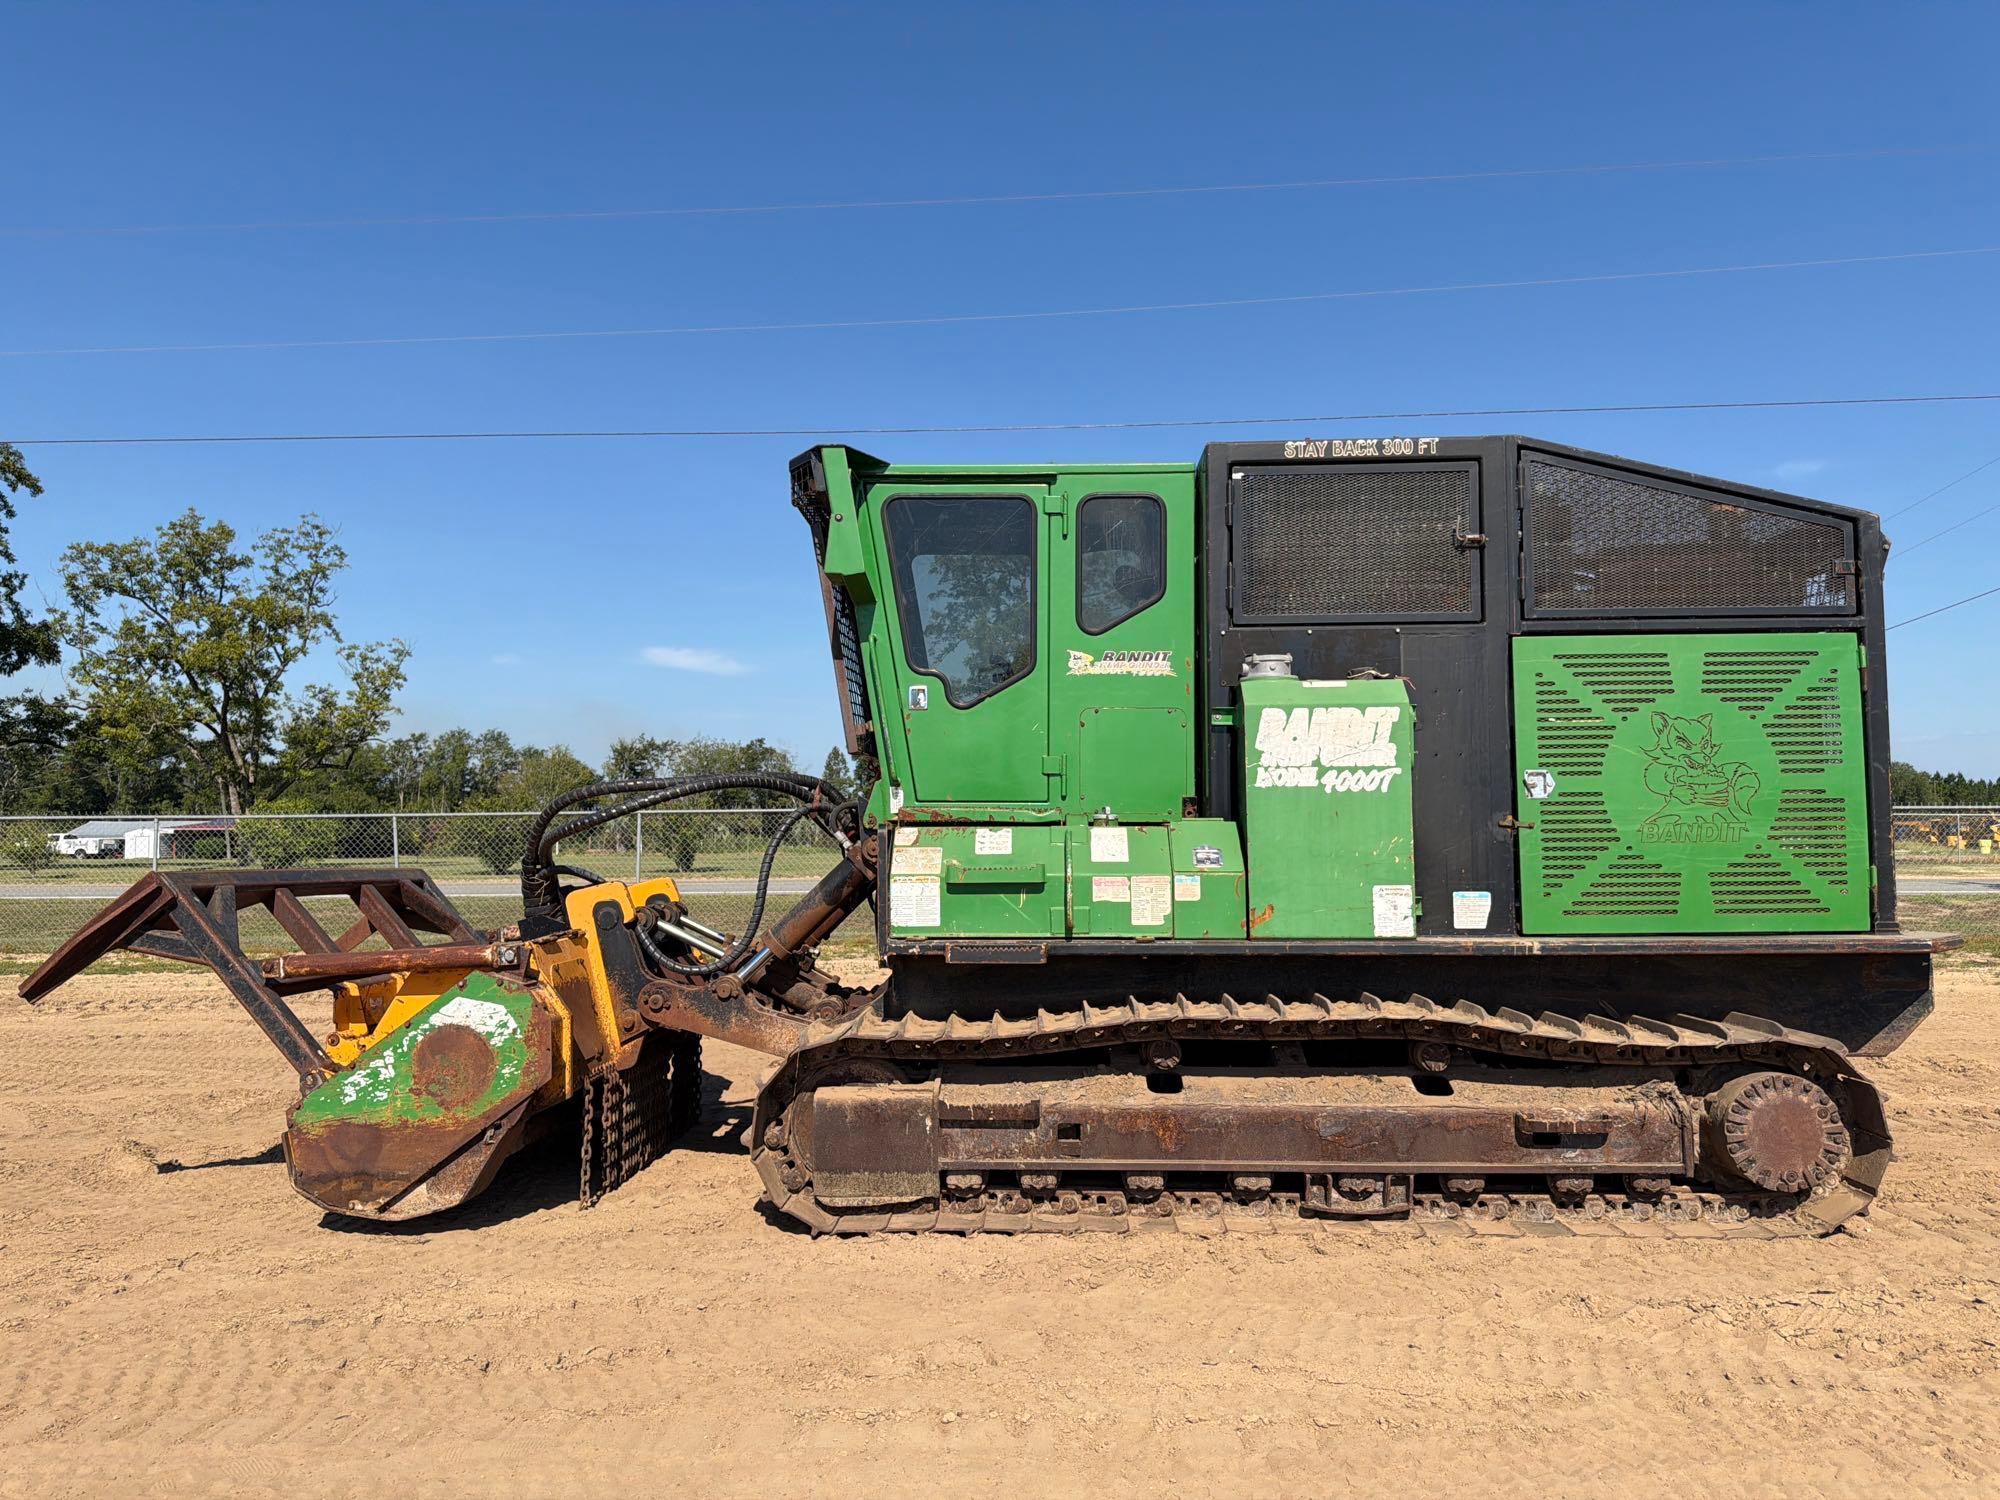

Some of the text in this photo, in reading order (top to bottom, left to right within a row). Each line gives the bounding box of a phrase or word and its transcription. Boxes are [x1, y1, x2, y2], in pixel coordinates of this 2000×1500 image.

[1284, 437, 1439, 459] STAY BACK 300 FT
[1102, 650, 1172, 662] BANDIT
[1321, 767, 1402, 794] 4000T
[1640, 821, 1748, 844] BANDIT
